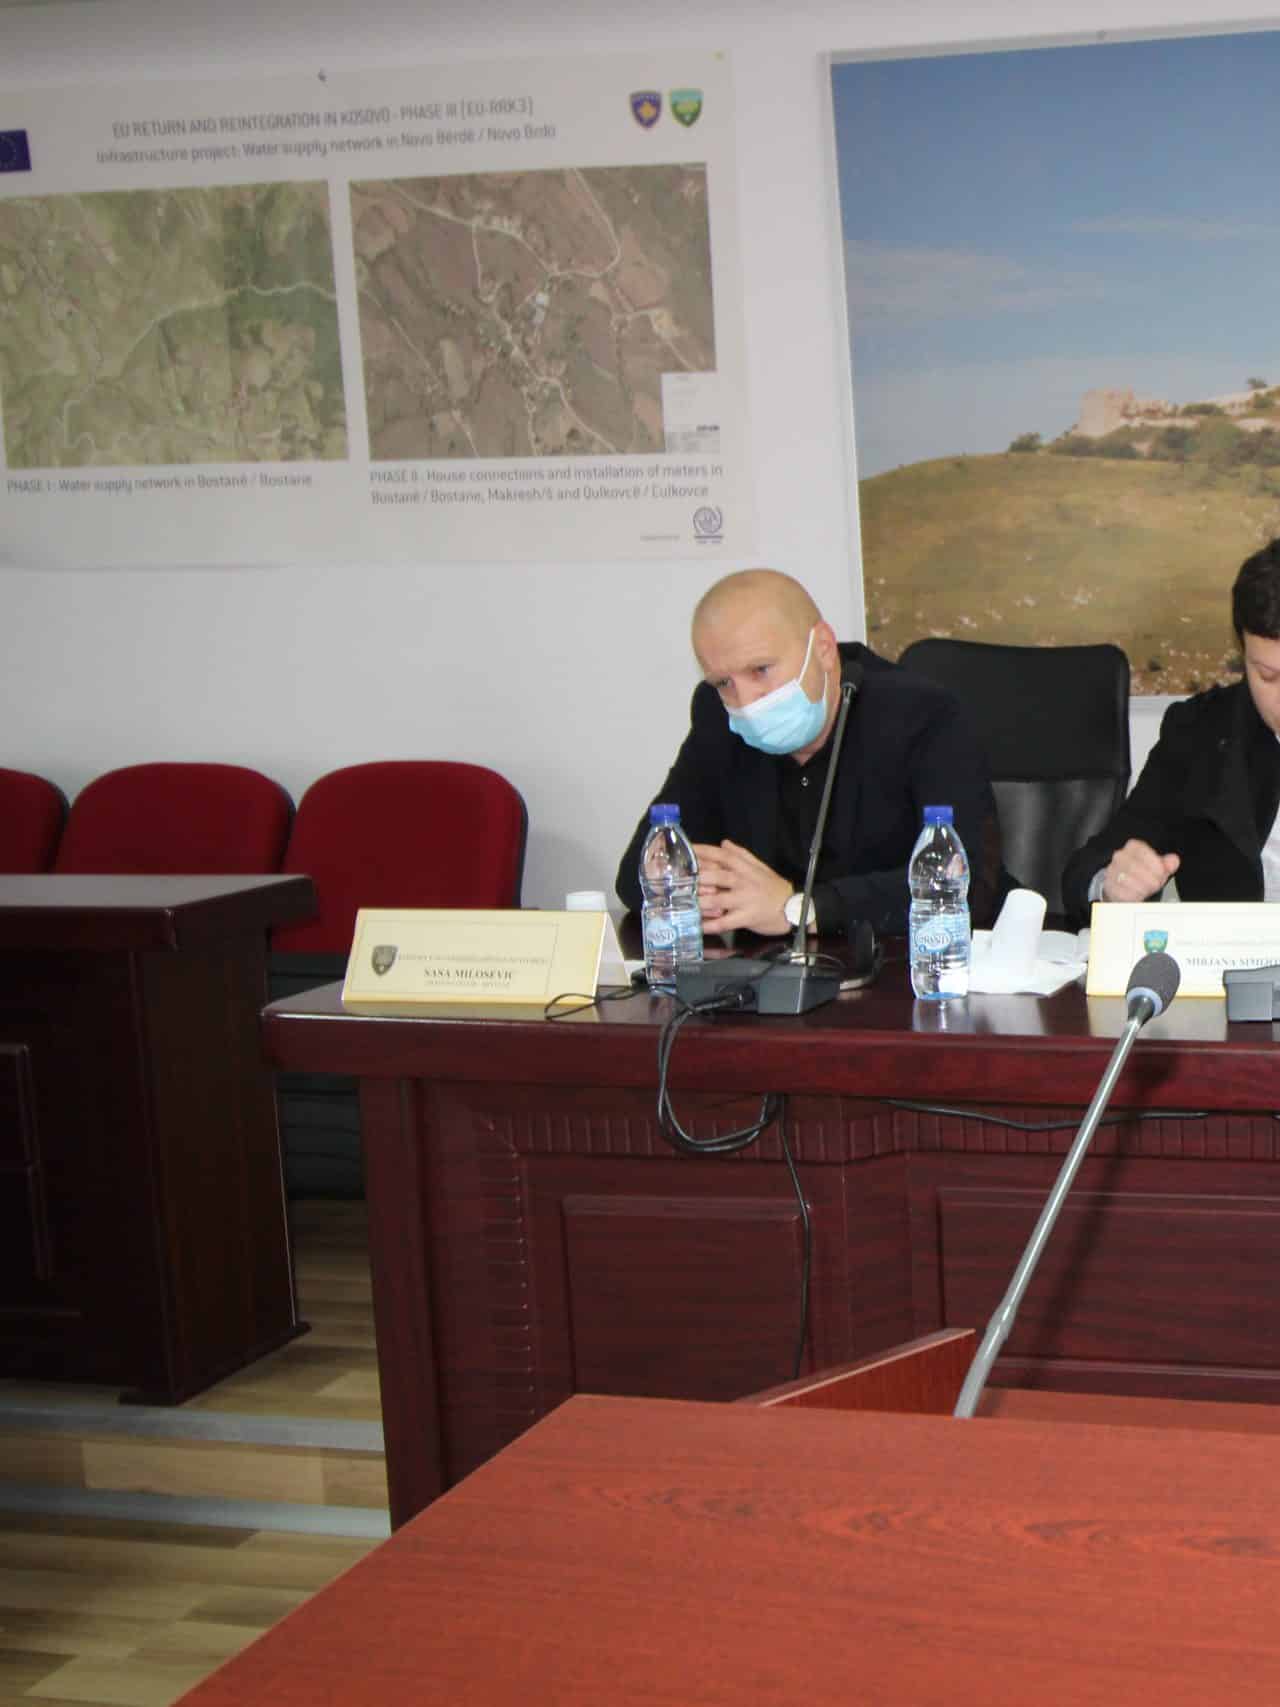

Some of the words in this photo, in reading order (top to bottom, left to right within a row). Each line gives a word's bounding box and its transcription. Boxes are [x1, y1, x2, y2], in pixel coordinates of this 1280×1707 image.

[112, 119, 130, 137] EU
[133, 118, 186, 136] RETURN
[190, 115, 217, 134] AND
[219, 111, 320, 132] REINTEGRATION
[324, 111, 337, 128] IN
[341, 107, 391, 127] KOSOVO
[400, 103, 441, 121] PHASE
[96, 147, 188, 163] Infrastructure
[242, 142, 278, 157] Water
[281, 139, 329, 158] supply
[330, 134, 383, 153] network
[386, 134, 399, 148] in
[487, 125, 521, 142] Novo
[524, 122, 556, 139] Brdo
[370, 469, 407, 482] PHASE
[427, 468, 467, 481] House
[469, 467, 545, 481] connections
[547, 465, 571, 480] and
[574, 464, 643, 480] installation
[647, 464, 659, 478] of
[662, 464, 708, 478] meters
[711, 464, 723, 477] in
[7, 479, 41, 493] PHASE
[58, 478, 91, 491] Water
[94, 478, 133, 496] supply
[135, 475, 182, 490] network
[557, 485, 580, 500] and
